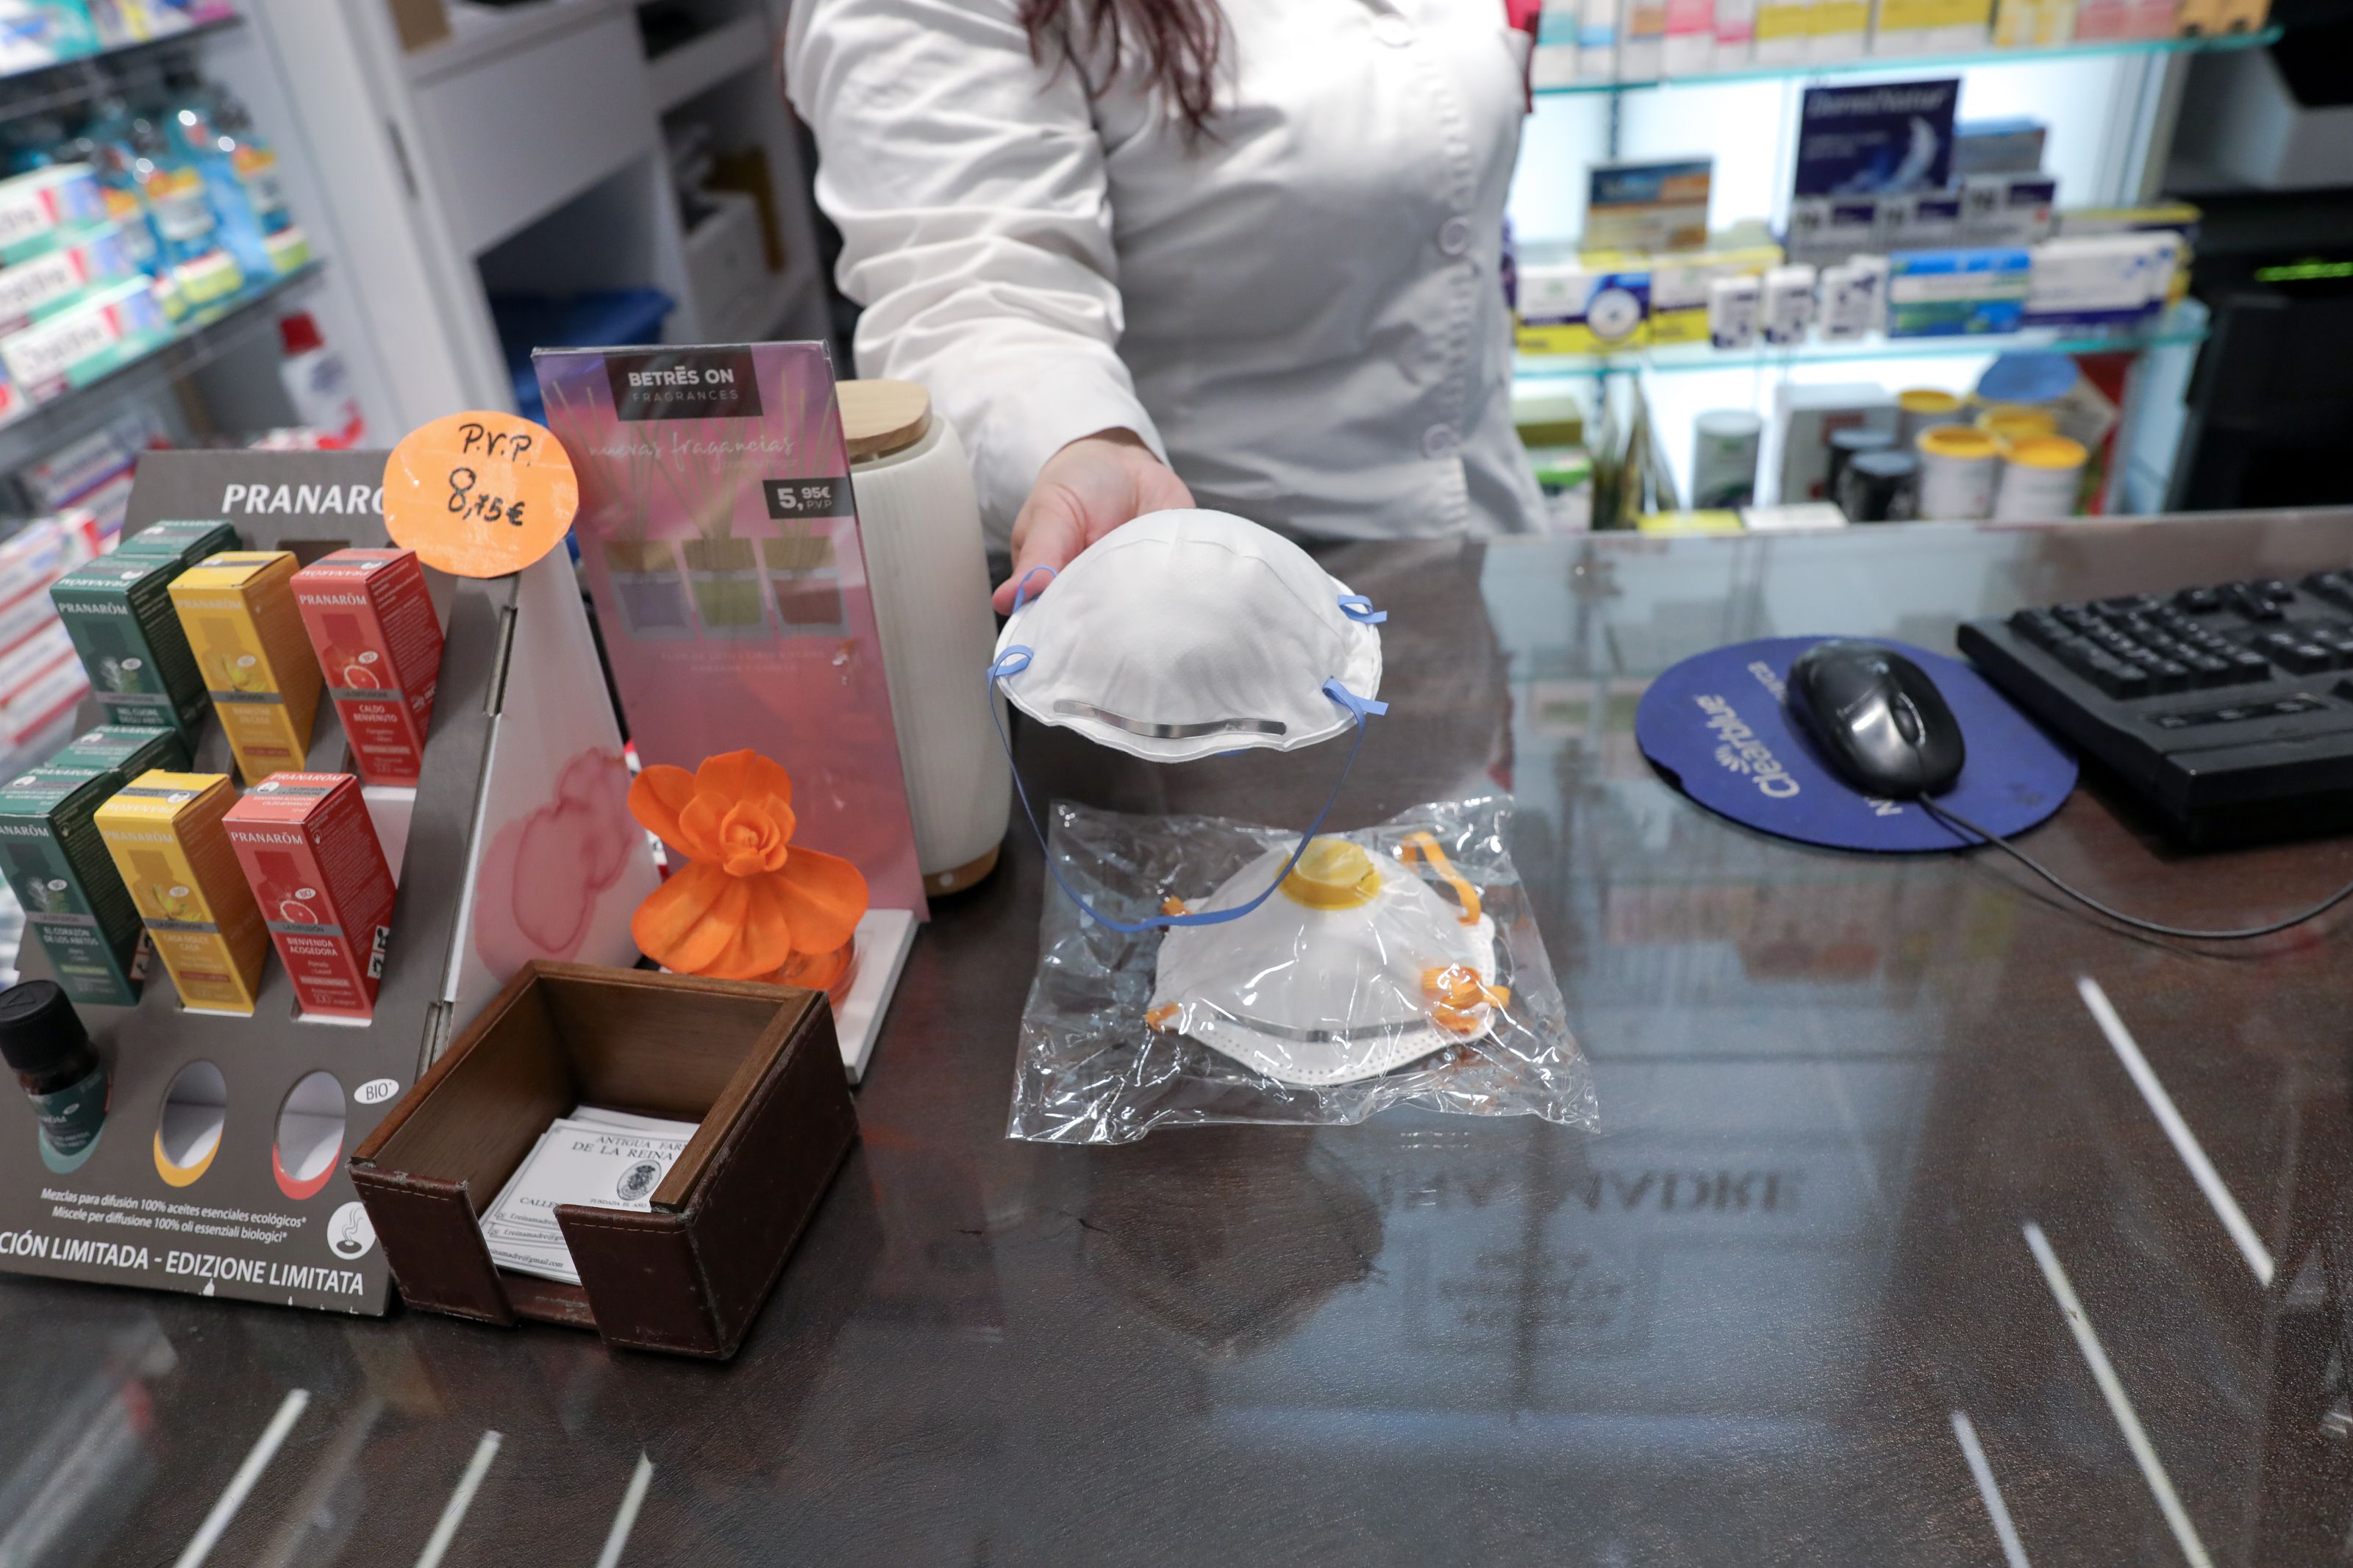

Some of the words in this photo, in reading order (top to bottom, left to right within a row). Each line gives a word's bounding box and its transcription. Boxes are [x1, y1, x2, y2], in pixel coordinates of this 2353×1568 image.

[704, 368, 735, 384] ON
[632, 390, 739, 403] FRAGRANCES
[670, 432, 795, 474] fragancias
[359, 704, 385, 713] CALDO
[353, 713, 398, 723] BENVENUTO
[286, 937, 334, 948] BIENVENIDA
[290, 945, 338, 956] ACOGEDORA
[596, 1135, 651, 1148] ANTIGUA
[572, 1141, 595, 1153] DE
[600, 1145, 620, 1156] LA
[626, 1149, 674, 1161] REINA
[40, 1188, 78, 1203] Mezclas
[77, 1194, 101, 1206] para
[101, 1194, 139, 1209] difusión
[140, 1199, 167, 1213] 100%
[167, 1203, 200, 1217] aceites
[201, 1208, 249, 1222] esenciales
[589, 1198, 620, 1207] FUNDADA
[52, 1206, 88, 1220] Miscele
[87, 1212, 105, 1223] per
[105, 1211, 153, 1228] diffusione
[154, 1217, 181, 1231] 100%
[181, 1220, 194, 1233] oli
[194, 1223, 240, 1238] essenziali
[51, 1237, 149, 1270] LIMITADA
[165, 1250, 267, 1284] EDIZIONE
[268, 1263, 364, 1296] LIMITATA
